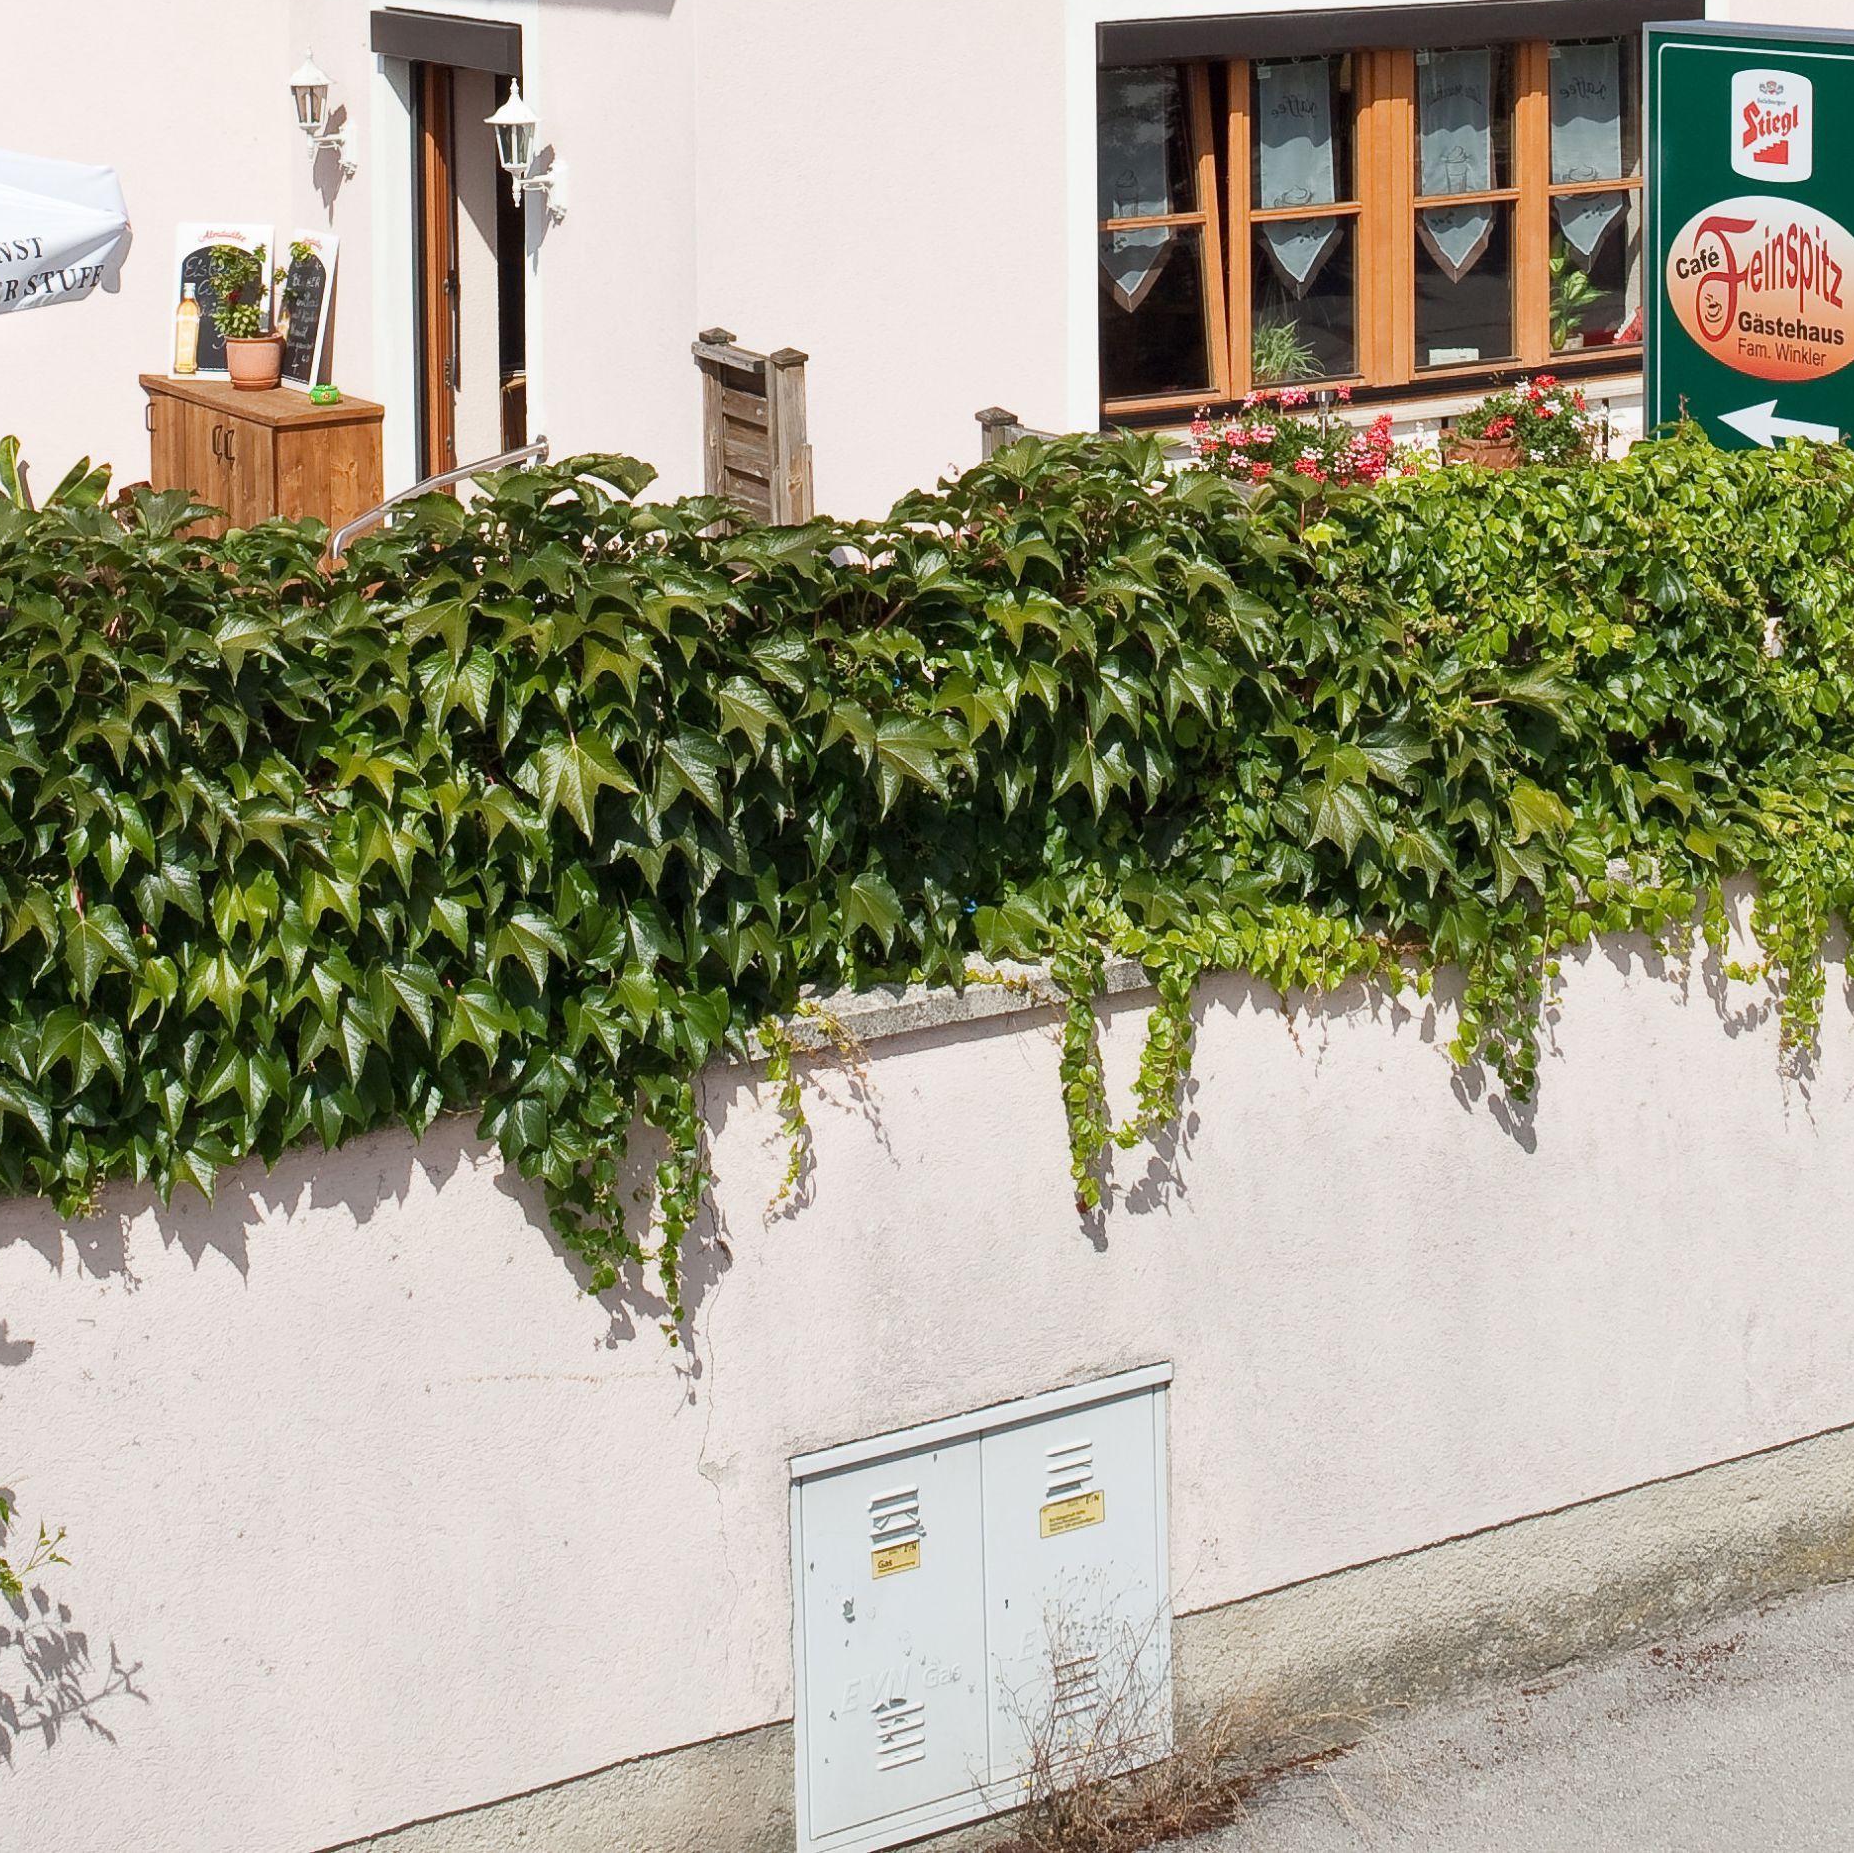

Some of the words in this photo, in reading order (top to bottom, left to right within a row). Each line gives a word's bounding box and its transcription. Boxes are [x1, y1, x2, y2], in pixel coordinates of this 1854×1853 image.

[1743, 101, 1799, 149] Stiegl
[1675, 245, 1721, 280] Café
[1693, 216, 1844, 342] Feinspitz
[1738, 310, 1845, 346] Gästehaus
[1737, 337, 1772, 360] Fam.
[1775, 343, 1828, 368] Winkler
